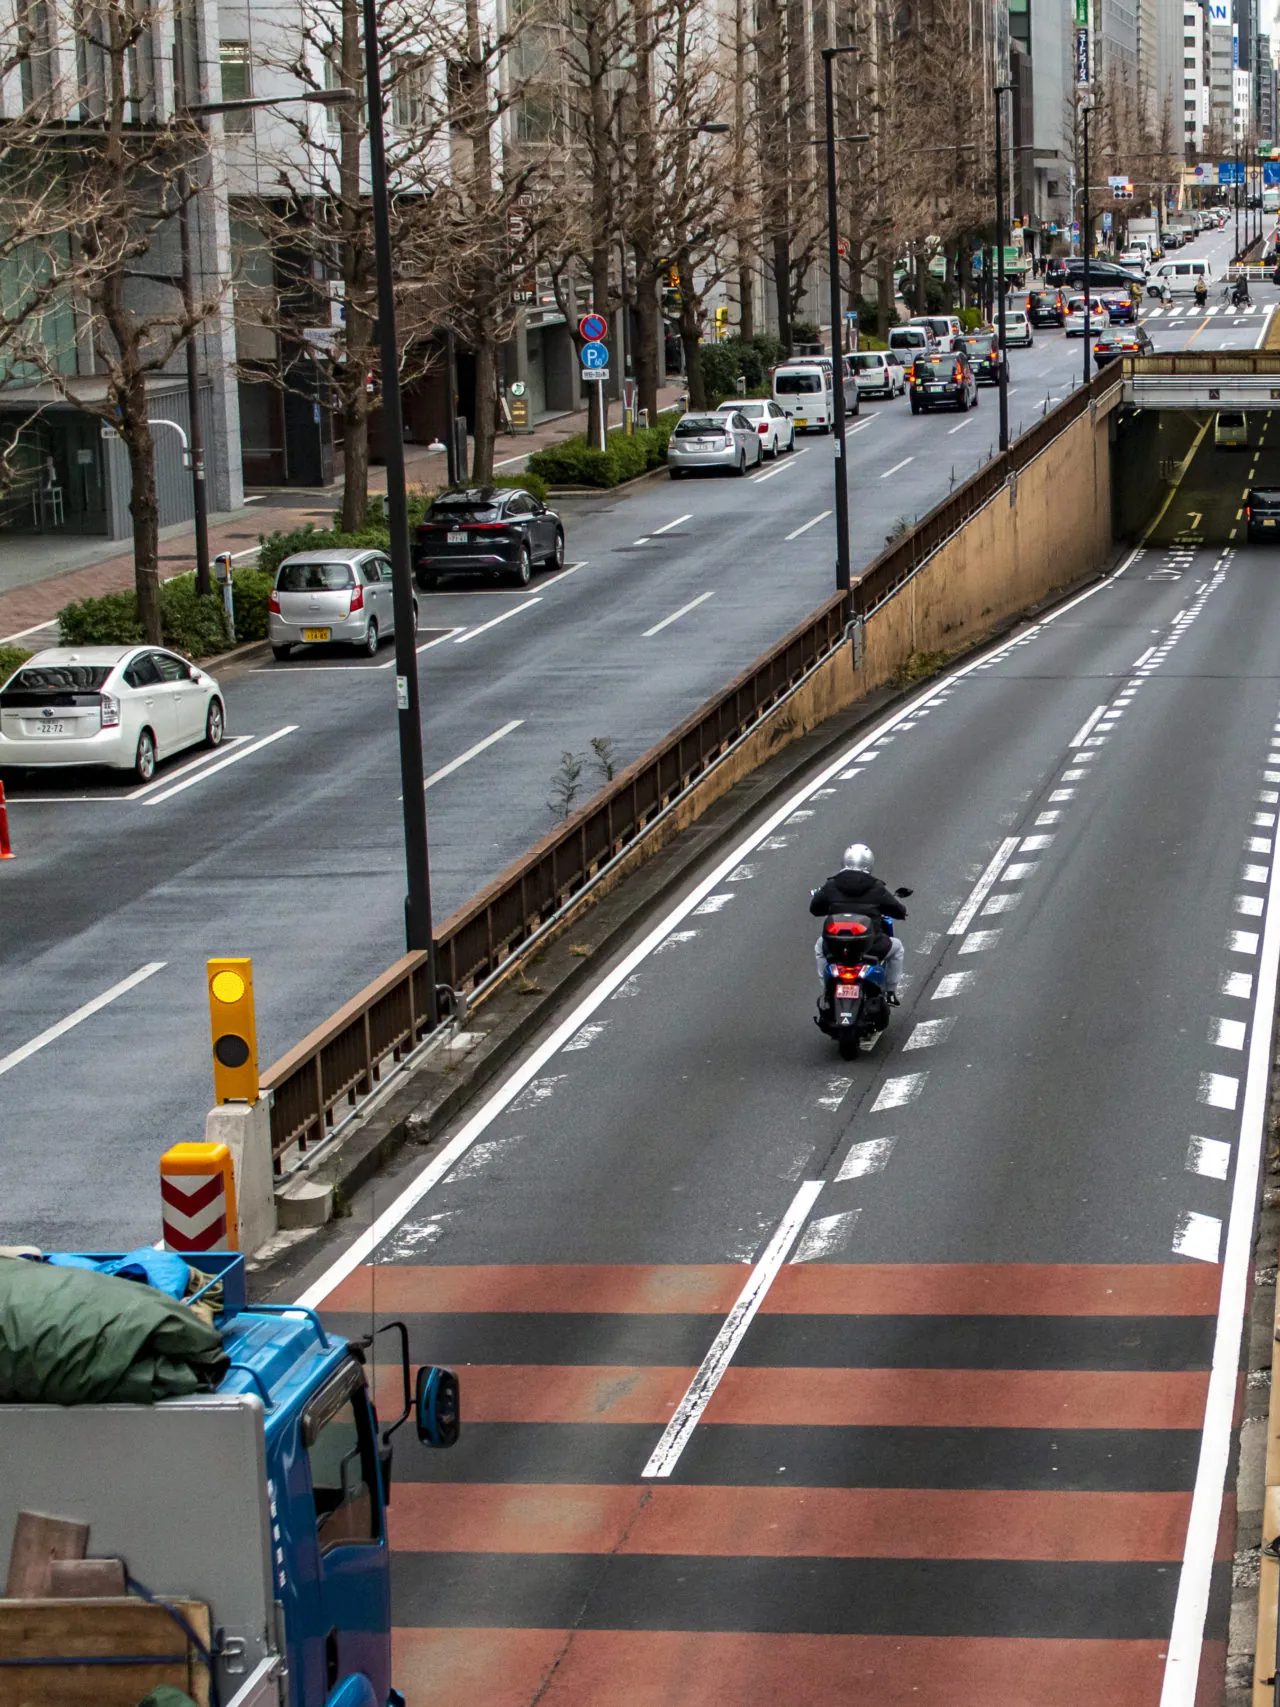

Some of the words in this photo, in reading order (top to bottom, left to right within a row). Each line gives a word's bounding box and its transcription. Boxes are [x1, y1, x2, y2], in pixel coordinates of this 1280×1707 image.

[514, 291, 533, 301] B1F
[587, 349, 598, 367] P
[595, 358, 603, 366] 60
[41, 724, 63, 733] 22-72
